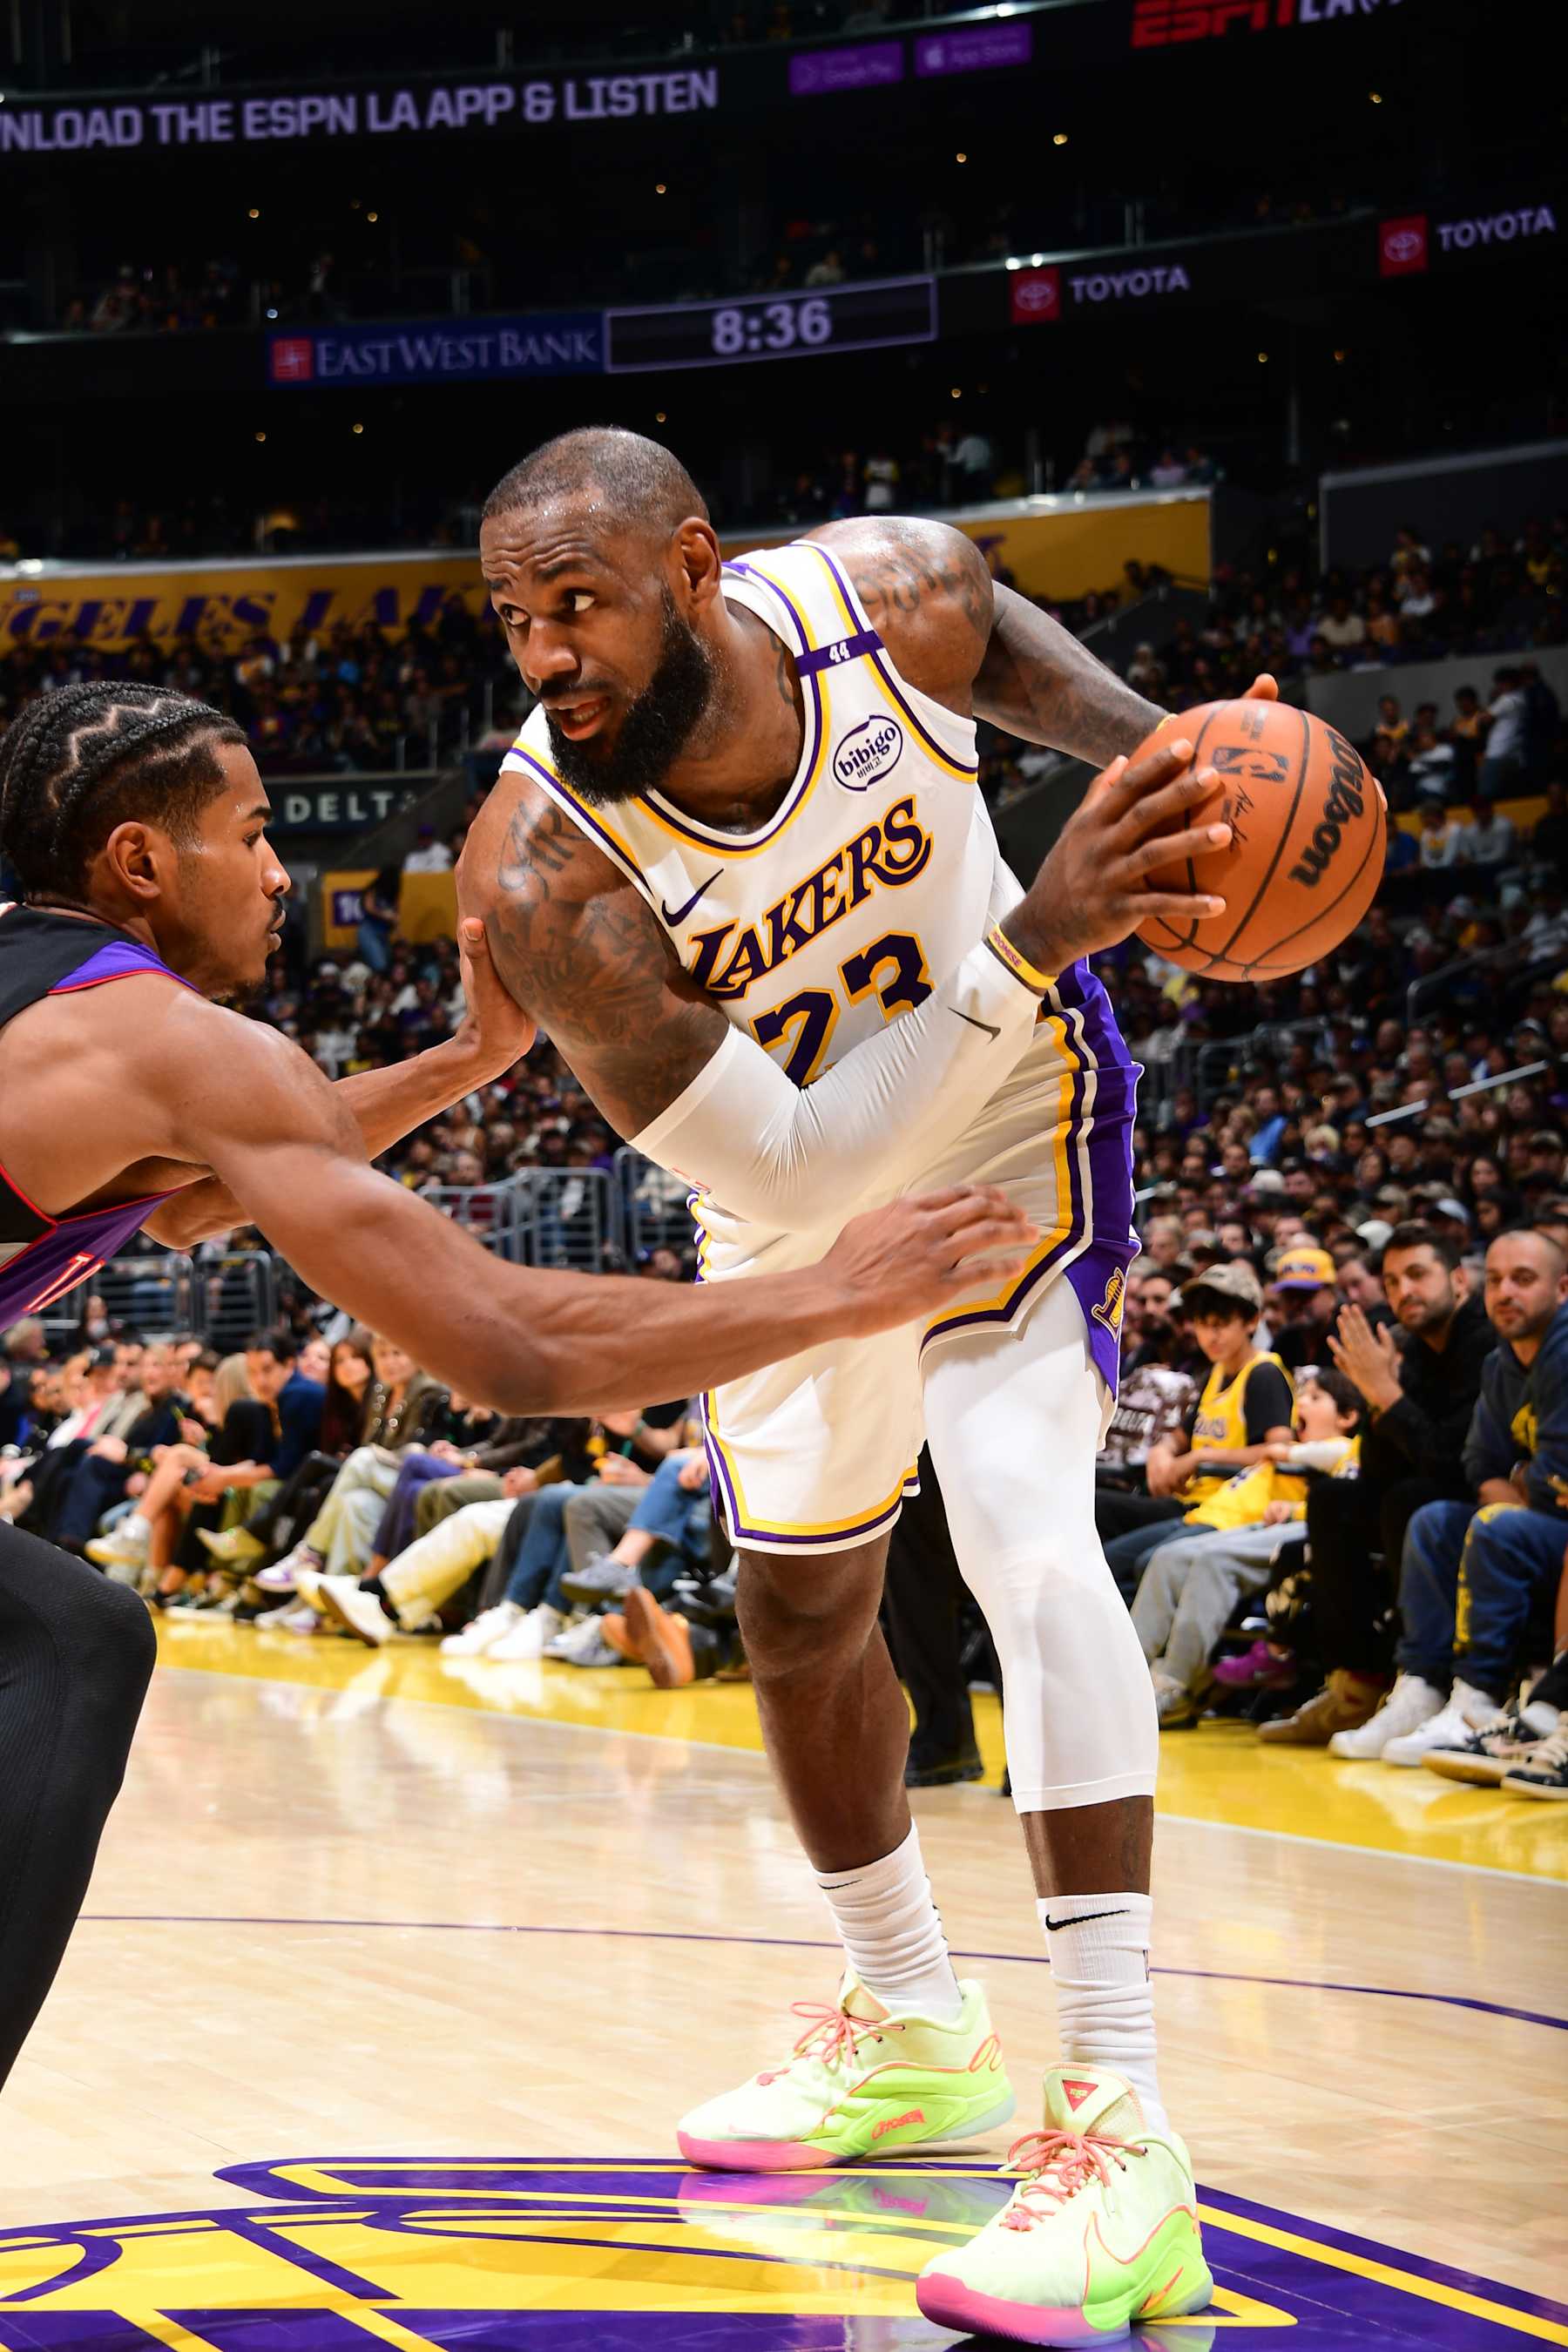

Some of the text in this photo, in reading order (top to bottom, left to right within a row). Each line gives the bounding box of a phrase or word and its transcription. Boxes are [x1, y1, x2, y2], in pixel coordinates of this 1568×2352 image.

[0, 66, 719, 153] NLOAD THE ESPN LA APP & LISTEN
[1437, 205, 1558, 252] TOYOTA
[1070, 265, 1191, 305] TOYOTA
[710, 297, 834, 356] 8:36
[314, 327, 601, 378] EAST WEST BANK
[0, 593, 275, 640] GELES
[829, 640, 851, 663] 44
[837, 726, 896, 777] bibigo
[1288, 727, 1365, 889] Wilson
[687, 794, 935, 1002] LAKERS
